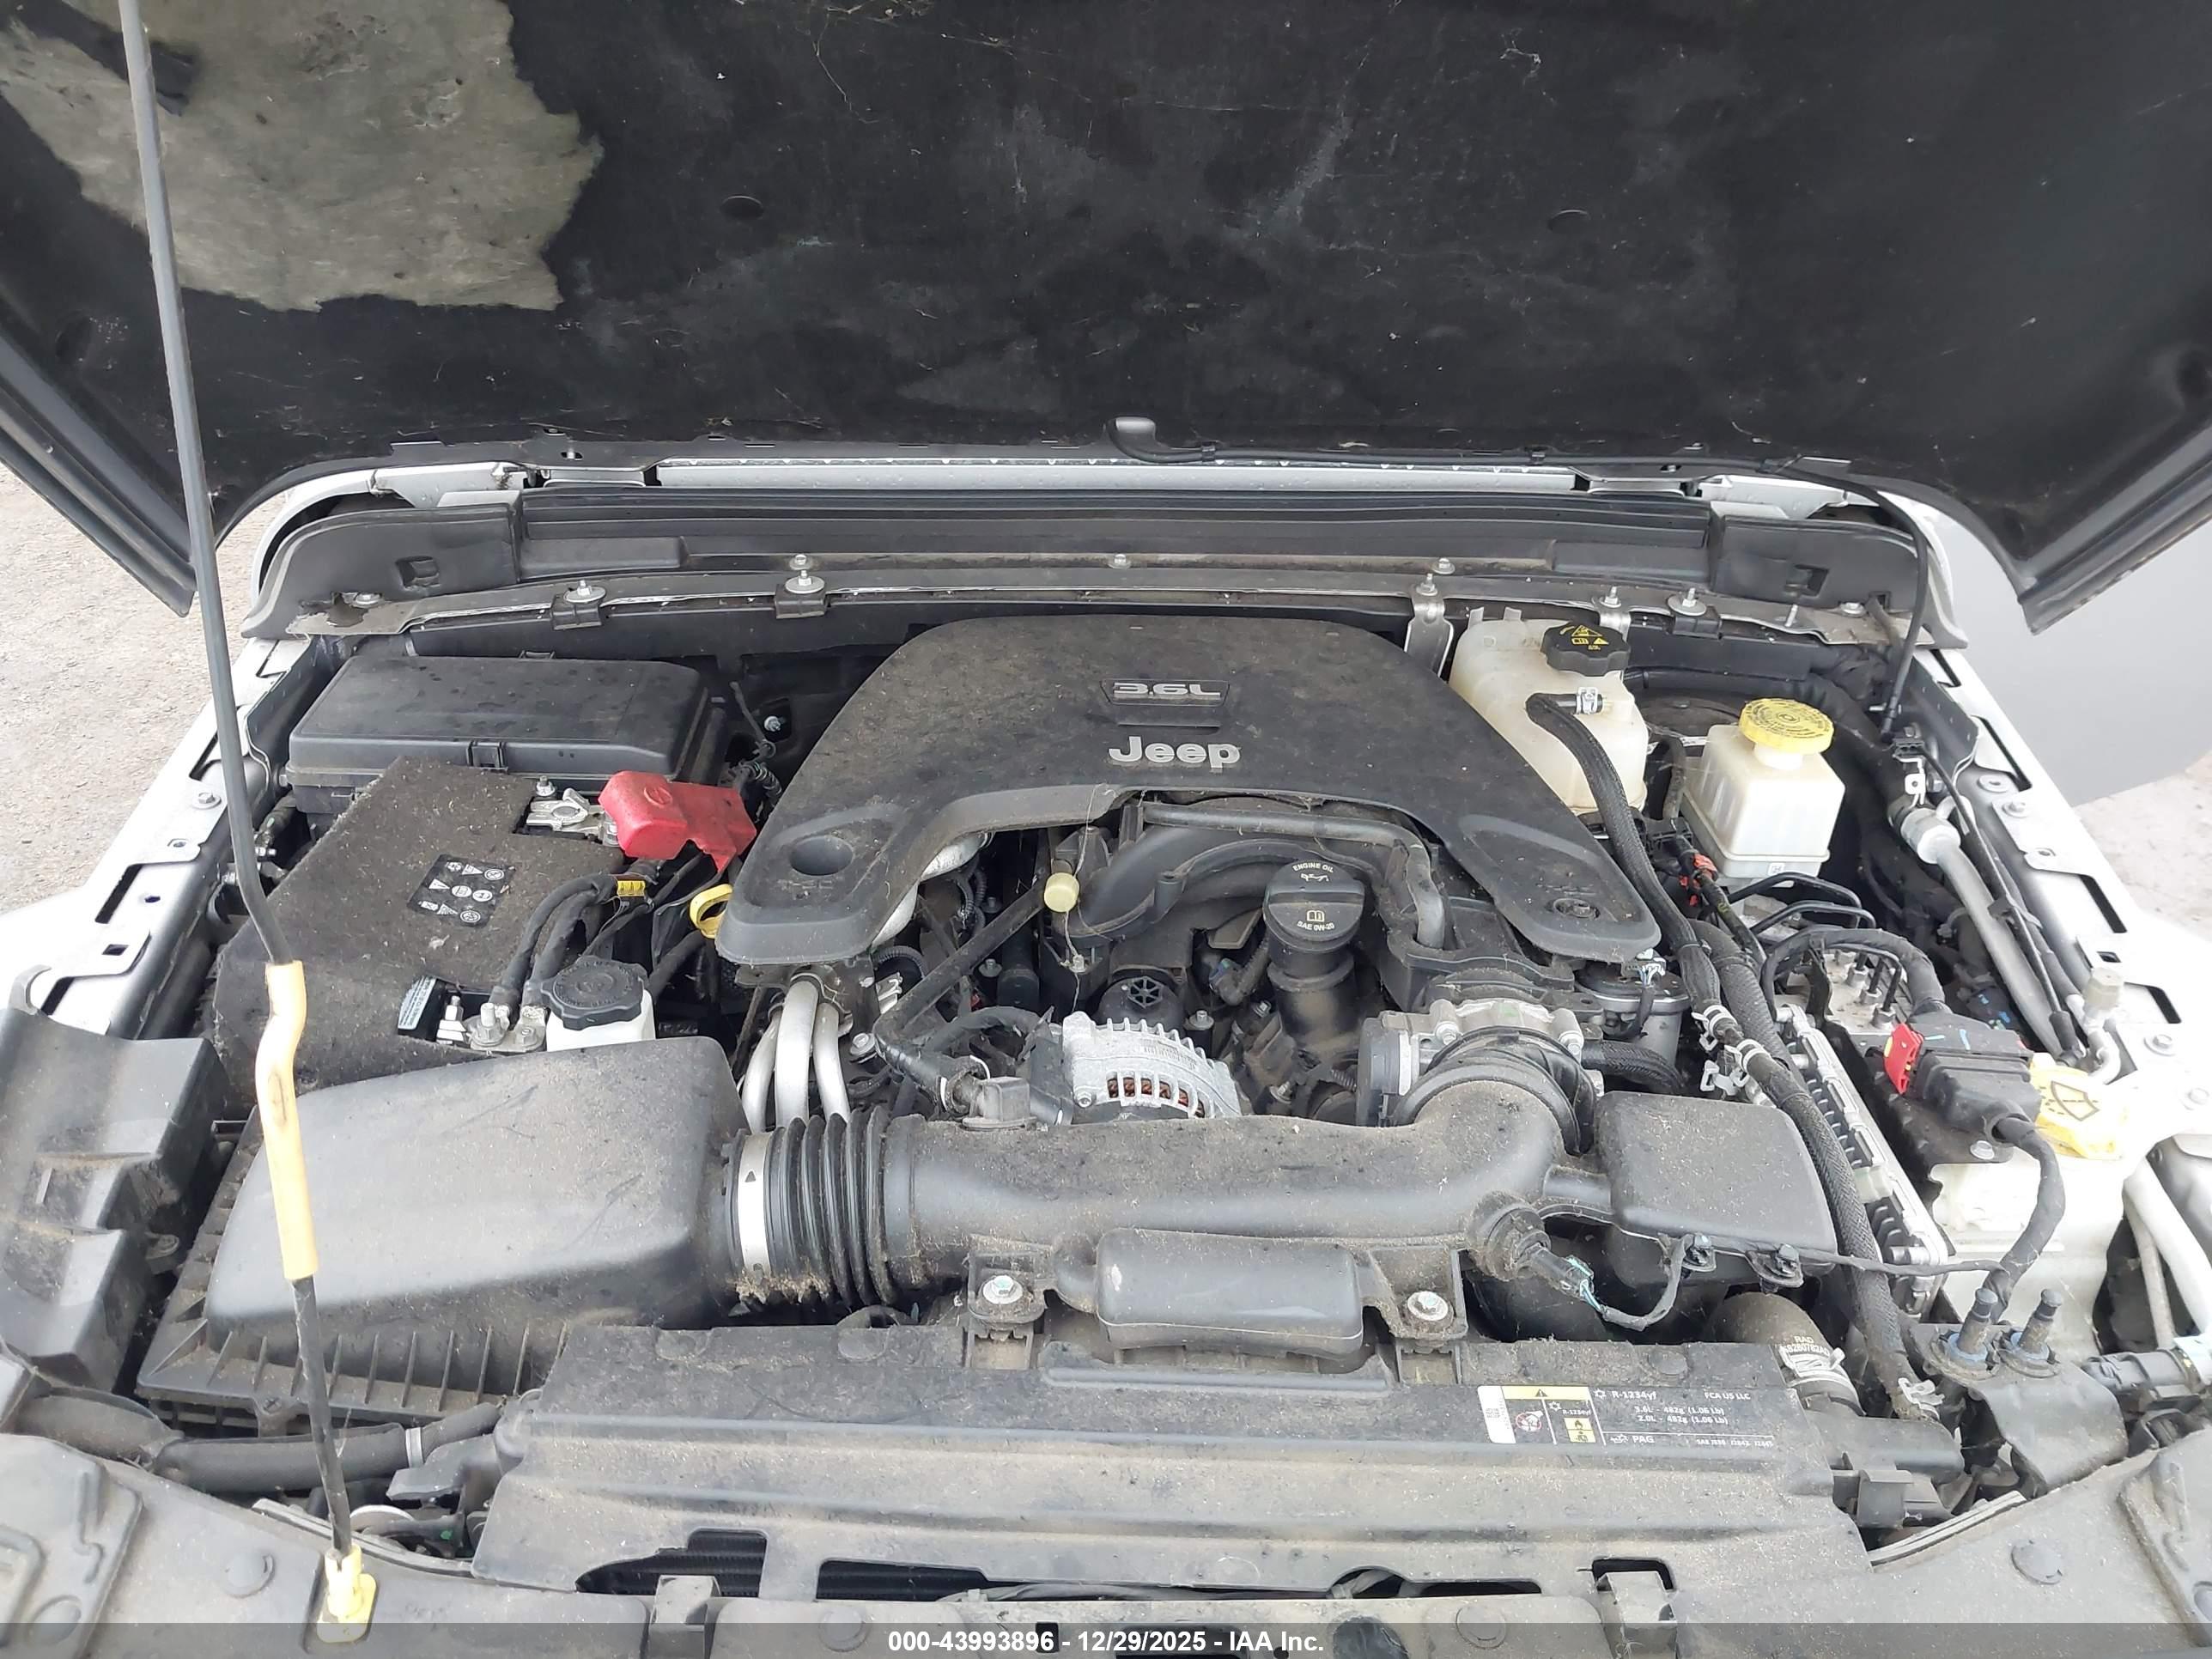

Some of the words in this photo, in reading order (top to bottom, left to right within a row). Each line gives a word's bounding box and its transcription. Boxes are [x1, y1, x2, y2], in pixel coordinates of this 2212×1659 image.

[1114, 683, 1221, 697] 3.6L
[1109, 736, 1242, 769] Jeep
[1292, 863, 1321, 872] ENGINE
[1322, 864, 1334, 873] OIL
[1297, 921, 1313, 931] SAE
[1313, 922, 1335, 932] 0W-20
[1794, 1335, 1814, 1344] RAD
[1612, 1390, 1656, 1400] R-1234yf
[1632, 1435, 1655, 1443] PAG
